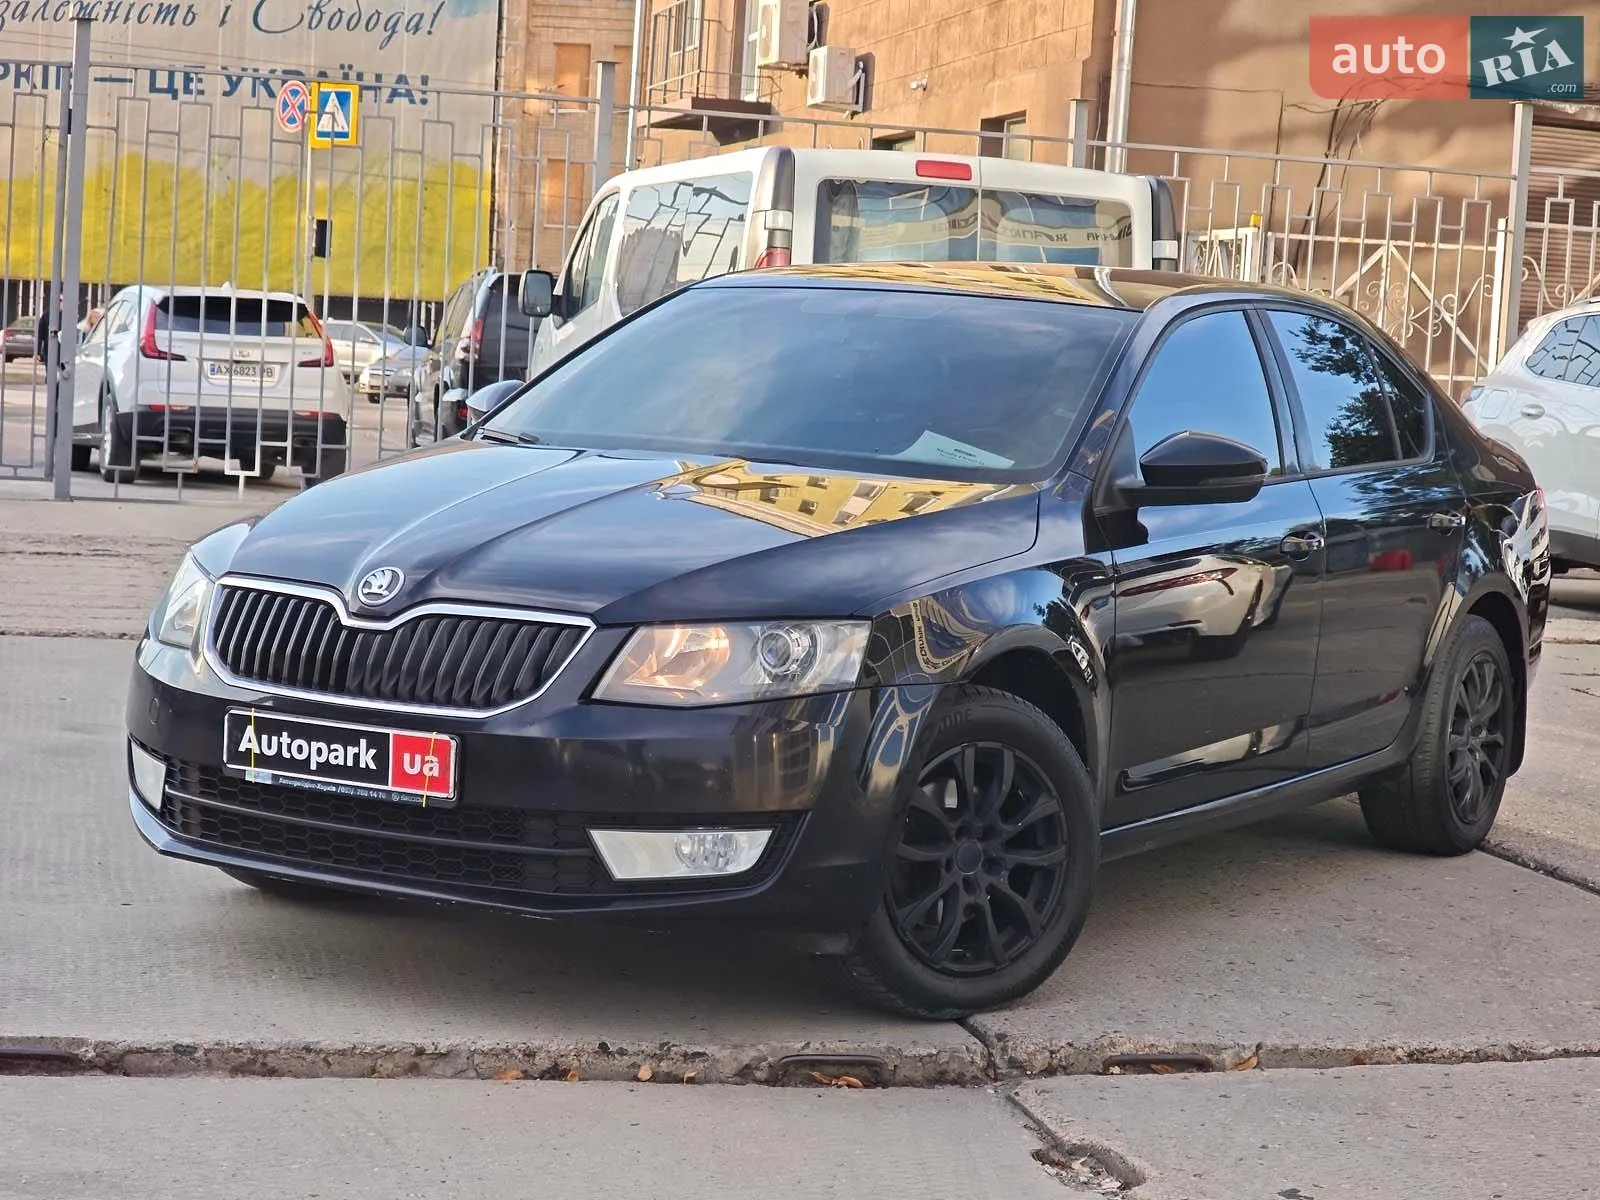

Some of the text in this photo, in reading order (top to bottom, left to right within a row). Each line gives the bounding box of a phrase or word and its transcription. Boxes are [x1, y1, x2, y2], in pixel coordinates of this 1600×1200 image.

[252, 0, 445, 50] Свобода!
[149, 64, 206, 100] ЦЕ
[238, 725, 440, 778] Autopark ua
